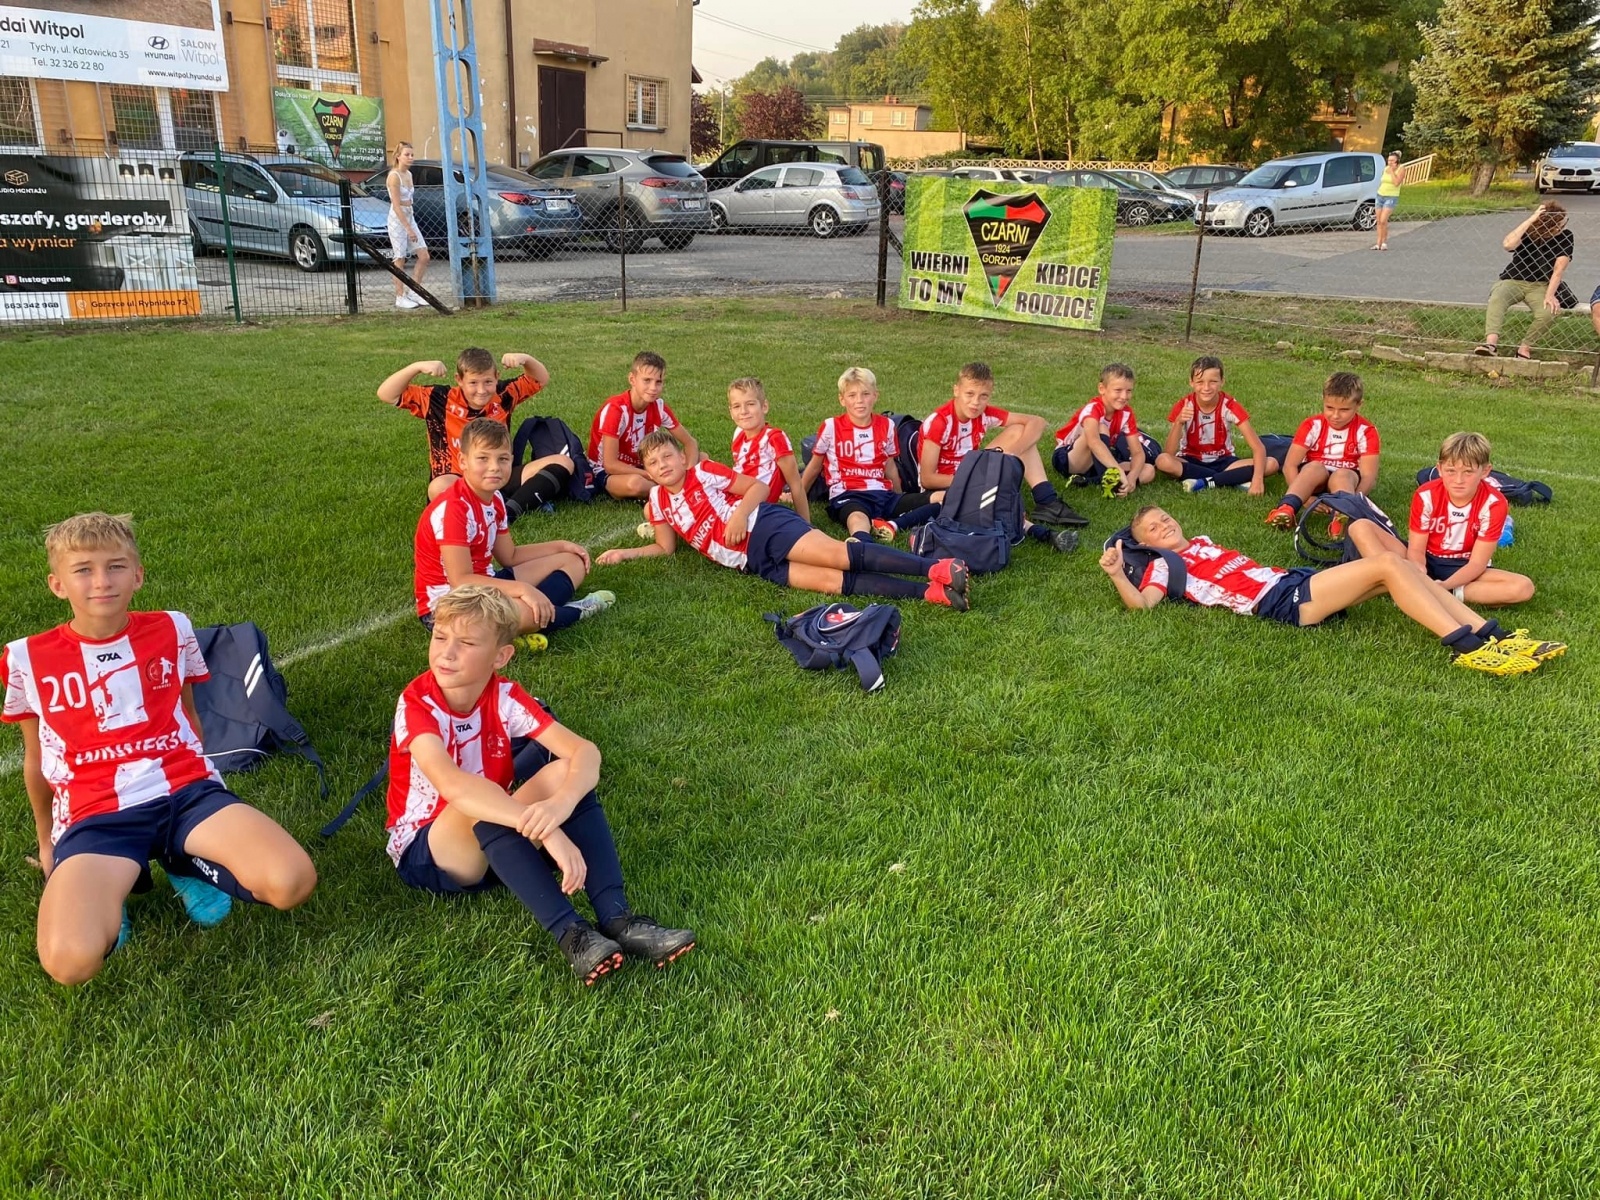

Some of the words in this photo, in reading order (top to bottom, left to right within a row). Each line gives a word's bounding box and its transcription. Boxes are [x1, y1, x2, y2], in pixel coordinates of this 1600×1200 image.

[0, 17, 26, 33] dai
[29, 19, 84, 39] Witpol
[1, 39, 10, 48] 21
[29, 41, 59, 54] Tychy,
[61, 45, 71, 53] ul.
[73, 46, 117, 57] Katowicka
[119, 51, 129, 59] 35
[180, 38, 217, 50] SALONY
[32, 57, 48, 66] Tel.
[50, 58, 60, 67] 32
[62, 59, 78, 69] 326
[81, 61, 91, 70] 22
[92, 62, 104, 71] 80
[144, 51, 175, 60] HYUNDAI
[181, 48, 220, 66] Witpol
[148, 70, 221, 81] www.witpol.hyundai.pl
[321, 115, 344, 128] CZARNI
[0, 210, 61, 229] szafy,
[64, 210, 167, 230] garderoby
[981, 221, 1031, 245] CZARNI
[11, 234, 76, 251] wymiar
[994, 244, 1010, 254] 1924
[910, 250, 969, 275] WIERNI
[982, 253, 1022, 266] GORZYCE
[19, 276, 71, 284] Instagramie
[1035, 262, 1101, 289] KIBICE
[908, 277, 933, 302] TO
[936, 280, 967, 306] MY
[91, 300, 125, 309] Gorzyce
[1014, 291, 1097, 321] RODZICE
[837, 440, 854, 458] 10
[41, 671, 87, 713] 20
